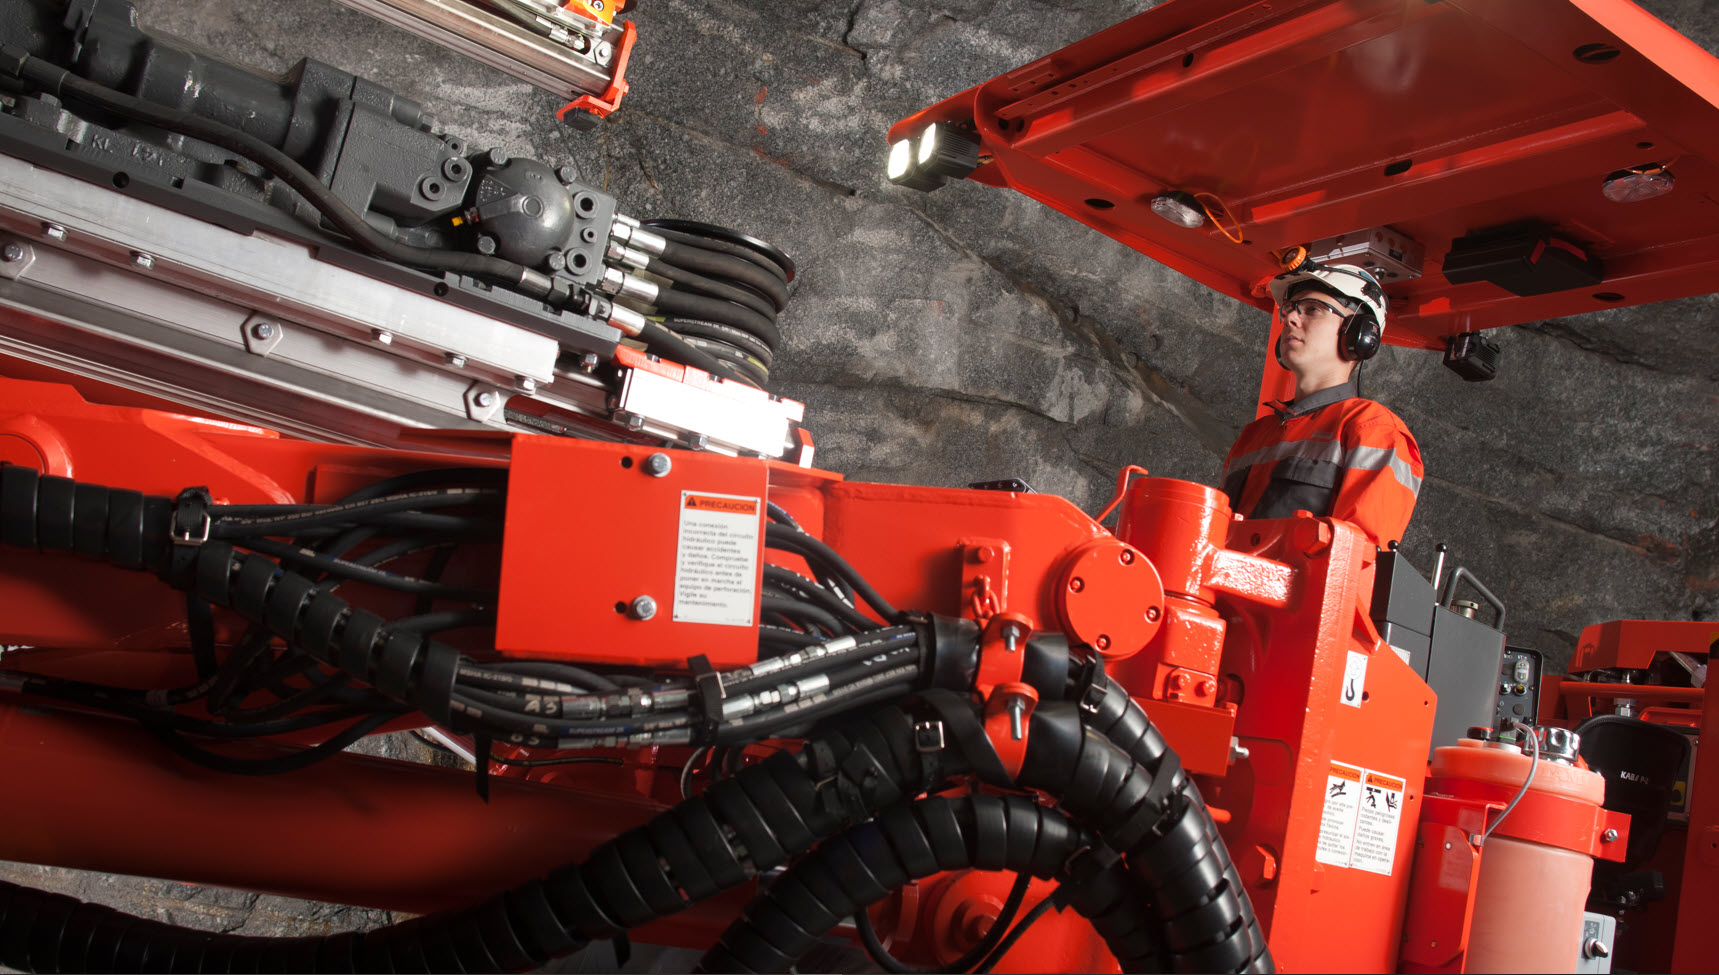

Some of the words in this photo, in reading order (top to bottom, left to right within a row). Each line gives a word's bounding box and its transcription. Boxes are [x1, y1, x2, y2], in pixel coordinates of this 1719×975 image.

[700, 500, 755, 511] PRECAUCION
[706, 546, 741, 554] accidentes
[711, 554, 749, 563] Compruebe
[687, 560, 715, 568] verifique
[678, 599, 728, 608] mantenimiento.
[1374, 777, 1403, 790] PRECAUCION
[1375, 811, 1395, 820] peligrosas
